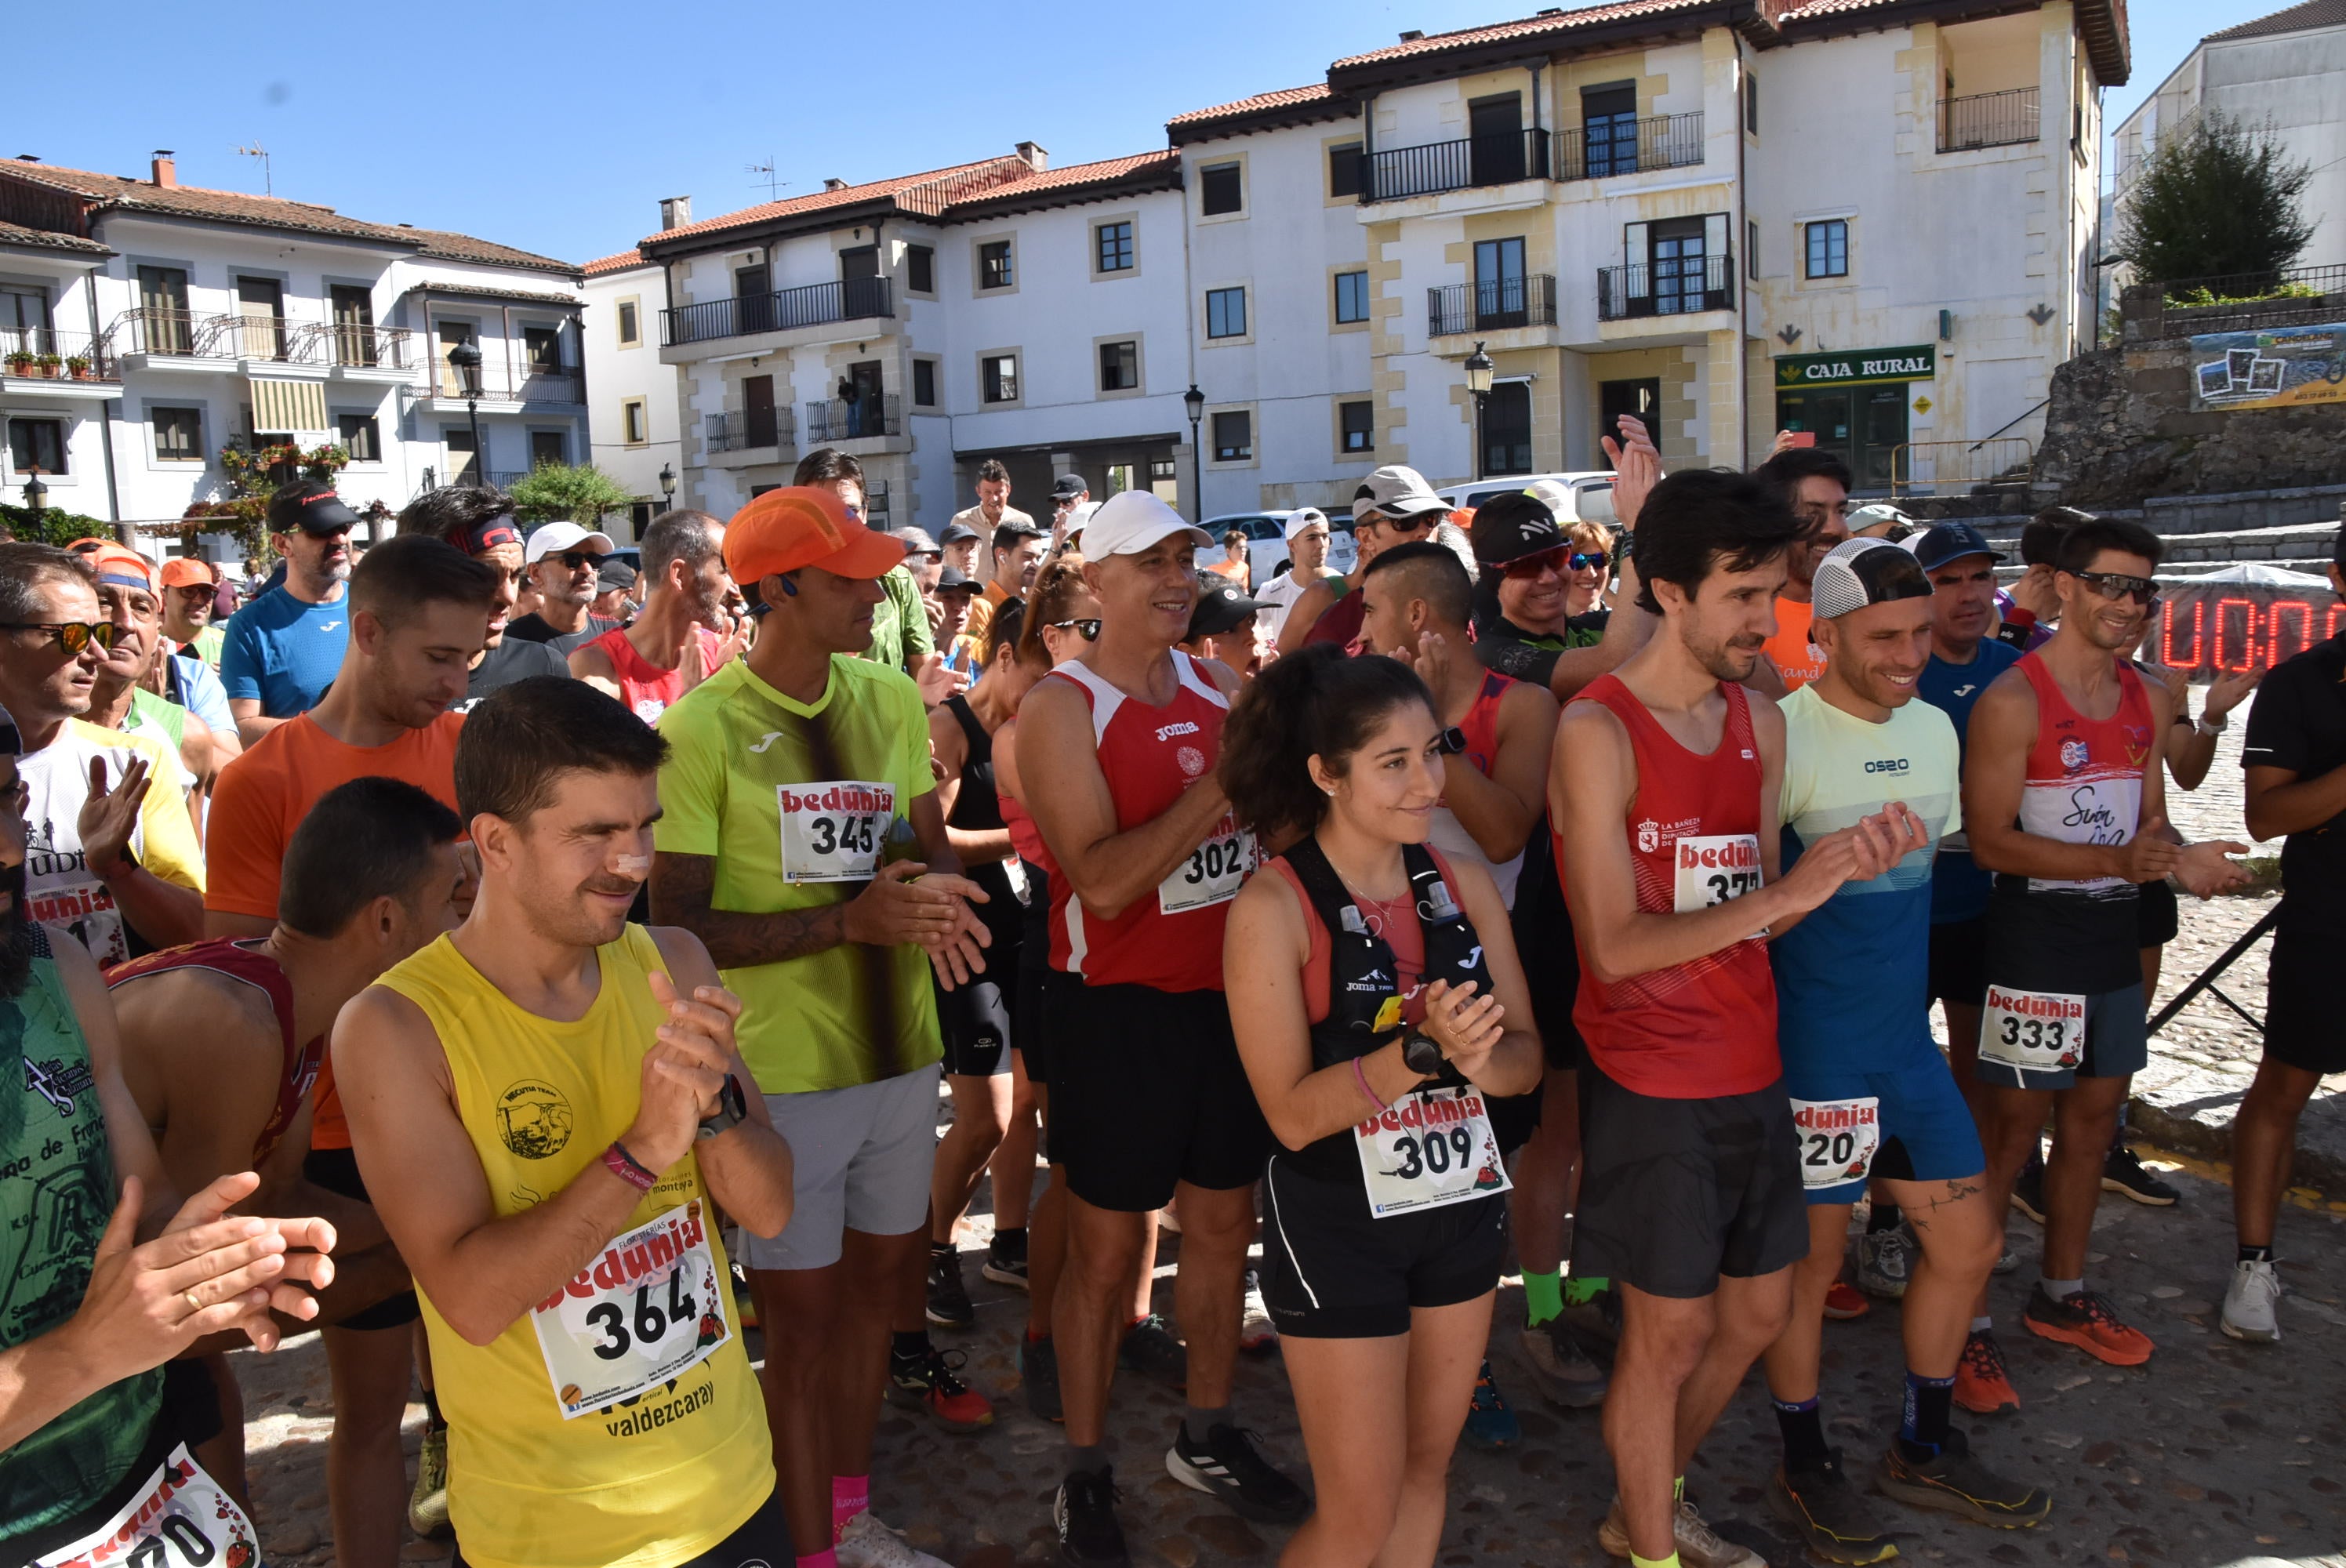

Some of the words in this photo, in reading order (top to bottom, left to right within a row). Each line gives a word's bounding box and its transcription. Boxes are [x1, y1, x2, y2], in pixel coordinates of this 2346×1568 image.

[1806, 362, 1854, 379] CAJA
[1861, 357, 1931, 376] RURAL
[781, 787, 893, 814] bedunia
[811, 816, 874, 855] 345
[1184, 838, 1241, 884] 302
[1988, 989, 2083, 1018] bedunia
[2000, 1016, 2064, 1051] 333
[41, 1138, 64, 1160] de
[1393, 1127, 1472, 1181] 309
[1795, 1131, 1854, 1166] 20
[618, 1220, 666, 1250] FLORISTERÍAS
[585, 1267, 697, 1360] 364
[606, 1381, 714, 1437] valdezcaray
